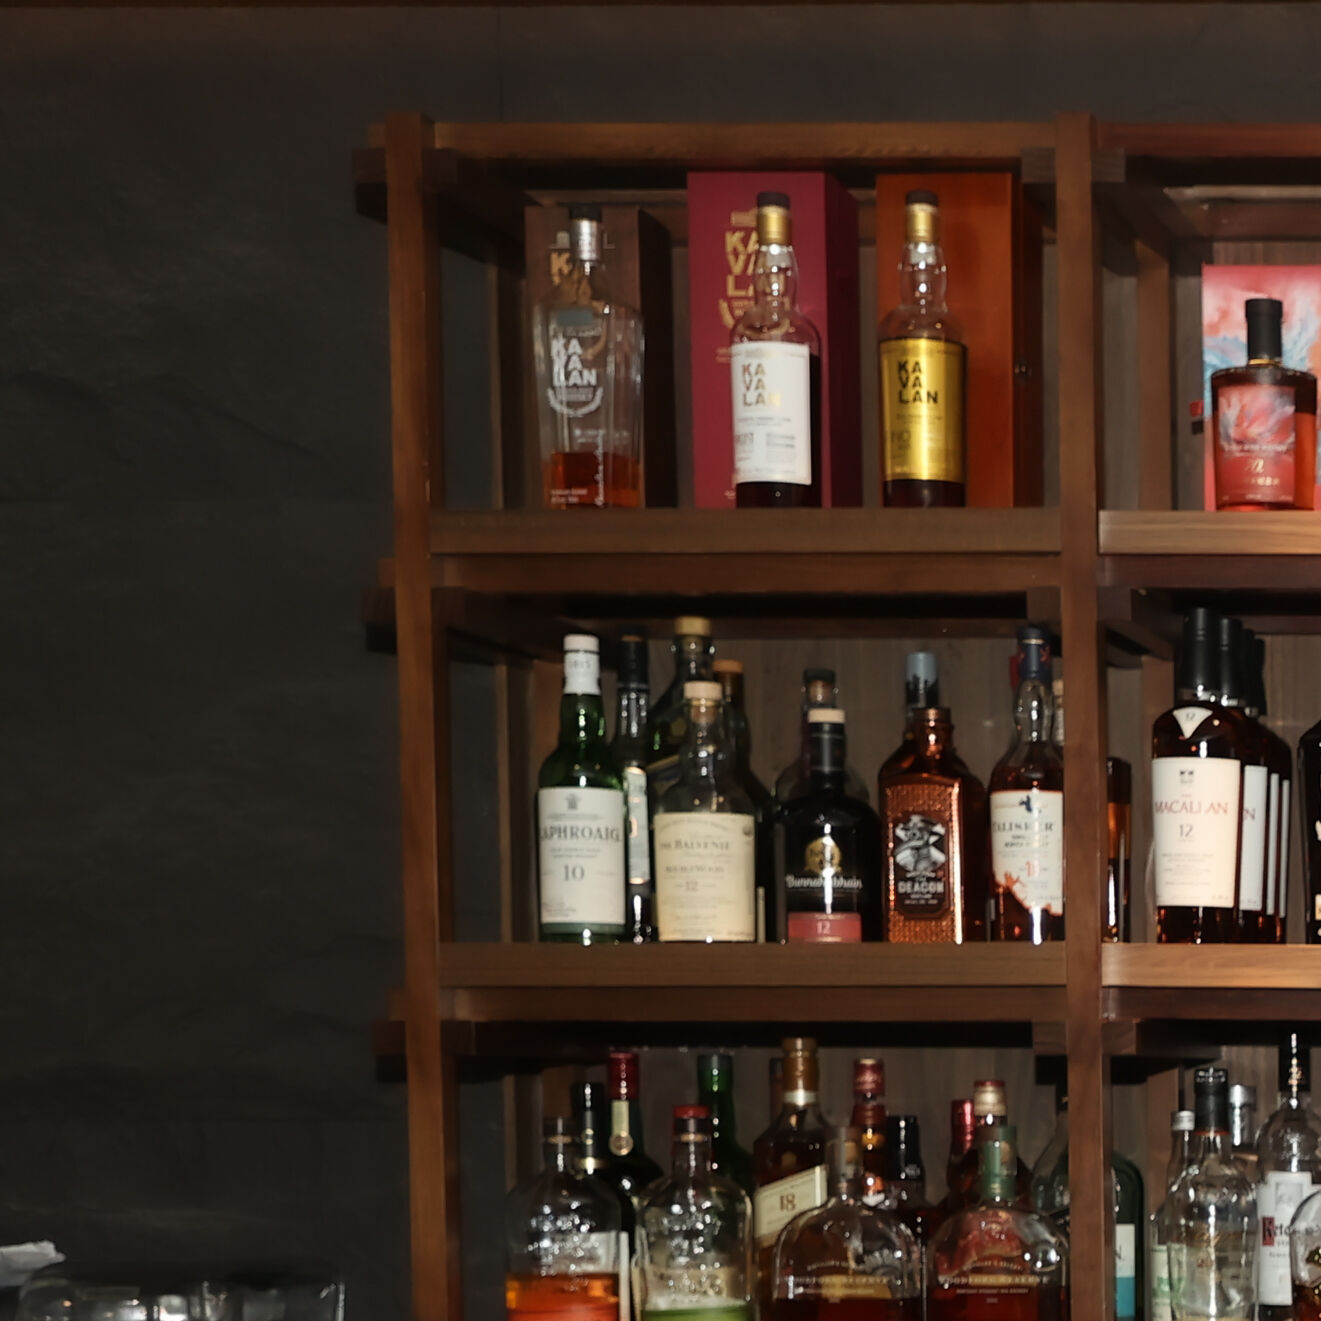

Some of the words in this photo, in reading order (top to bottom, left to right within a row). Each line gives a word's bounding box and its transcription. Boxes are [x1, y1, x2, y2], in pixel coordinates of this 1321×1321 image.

[742, 363, 766, 379] KA
[897, 360, 922, 374] KA
[743, 380, 766, 392] VA
[897, 376, 922, 389] VA
[898, 390, 938, 404] LAN
[1154, 800, 1229, 815] MACALLAN
[541, 825, 622, 843] APHROAIG
[1179, 824, 1194, 840] 12
[563, 865, 585, 882] 10
[897, 881, 945, 894] DEACON
[815, 920, 833, 935] 12
[779, 1193, 797, 1211] 18
